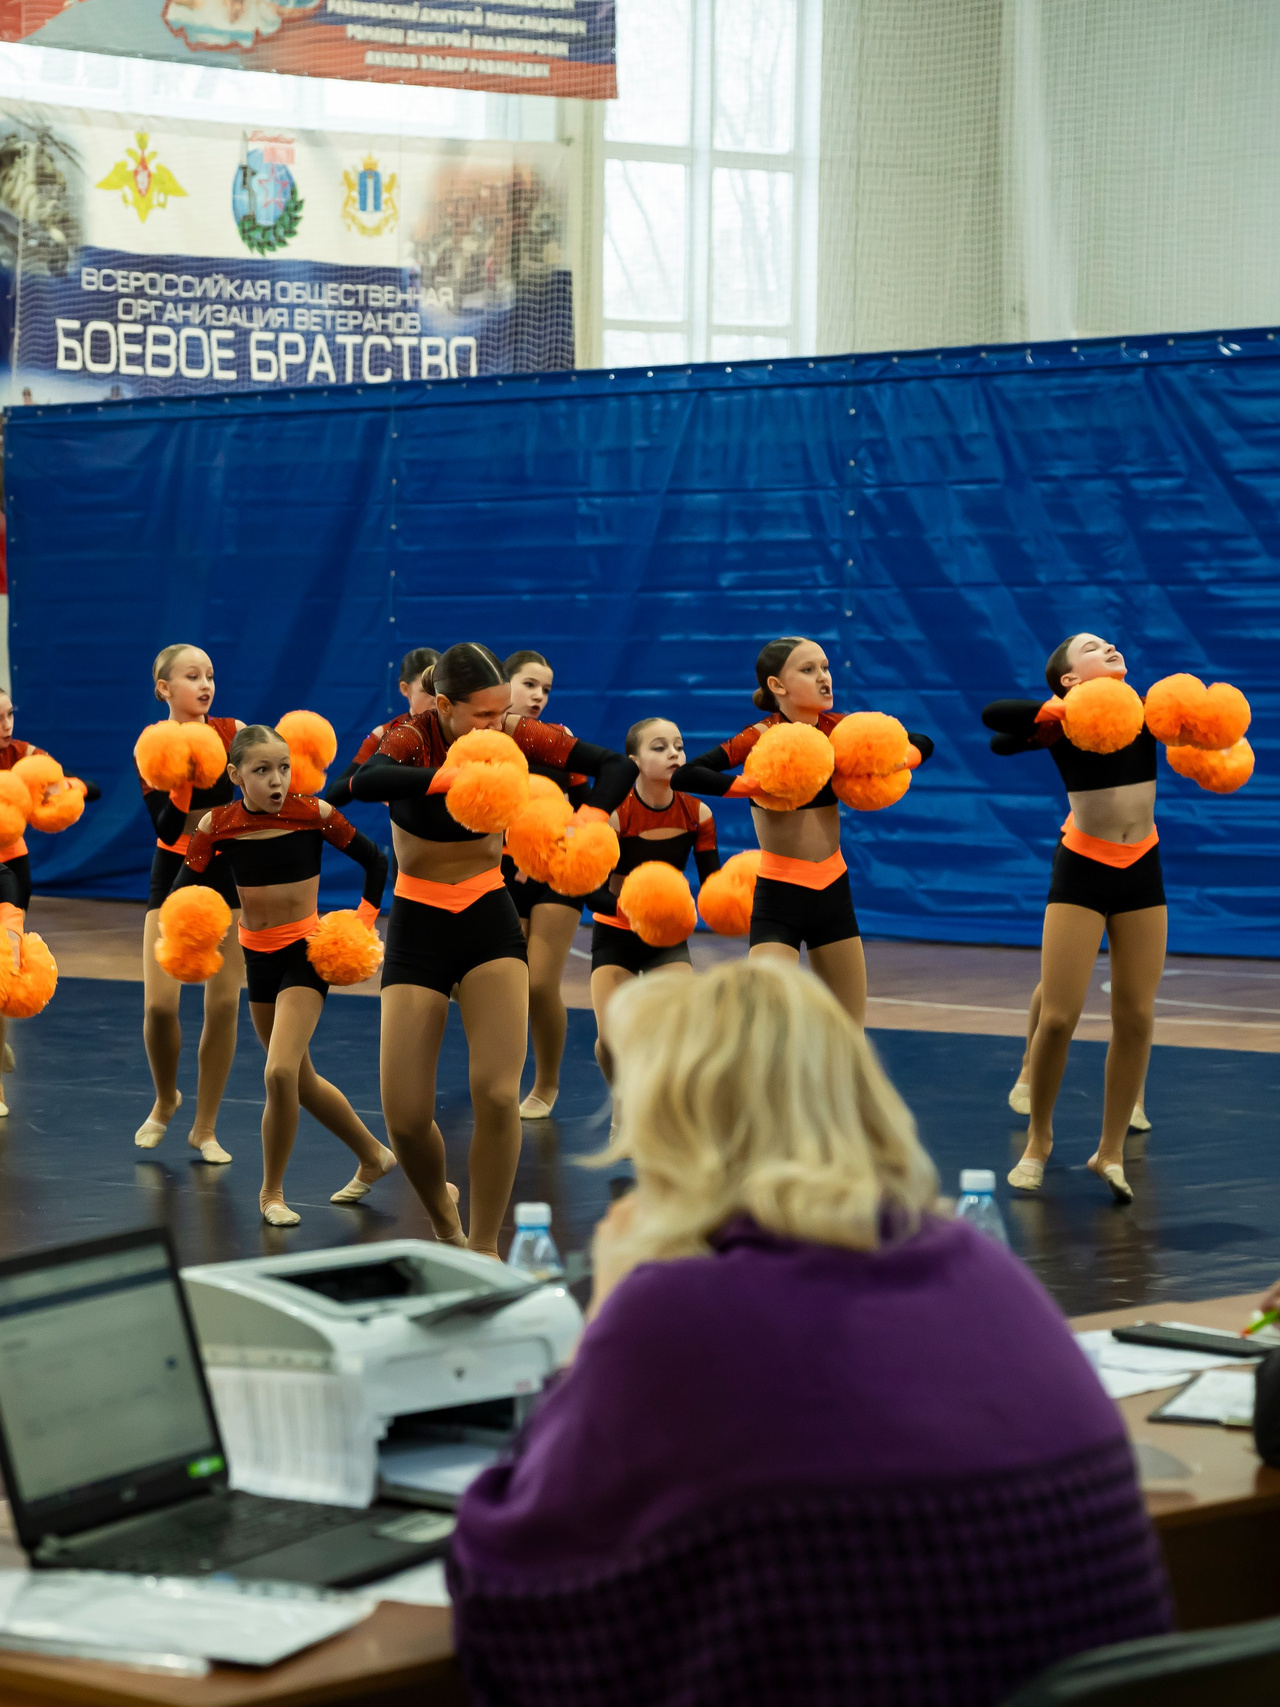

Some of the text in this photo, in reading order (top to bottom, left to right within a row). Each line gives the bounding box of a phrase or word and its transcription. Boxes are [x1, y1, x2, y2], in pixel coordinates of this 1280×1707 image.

[117, 297, 421, 335] ОРГАНИЗАЦИЯ ВЕТЕРАНОВ
[55, 318, 478, 384] БОЕВОЕ БРАТСТВО
